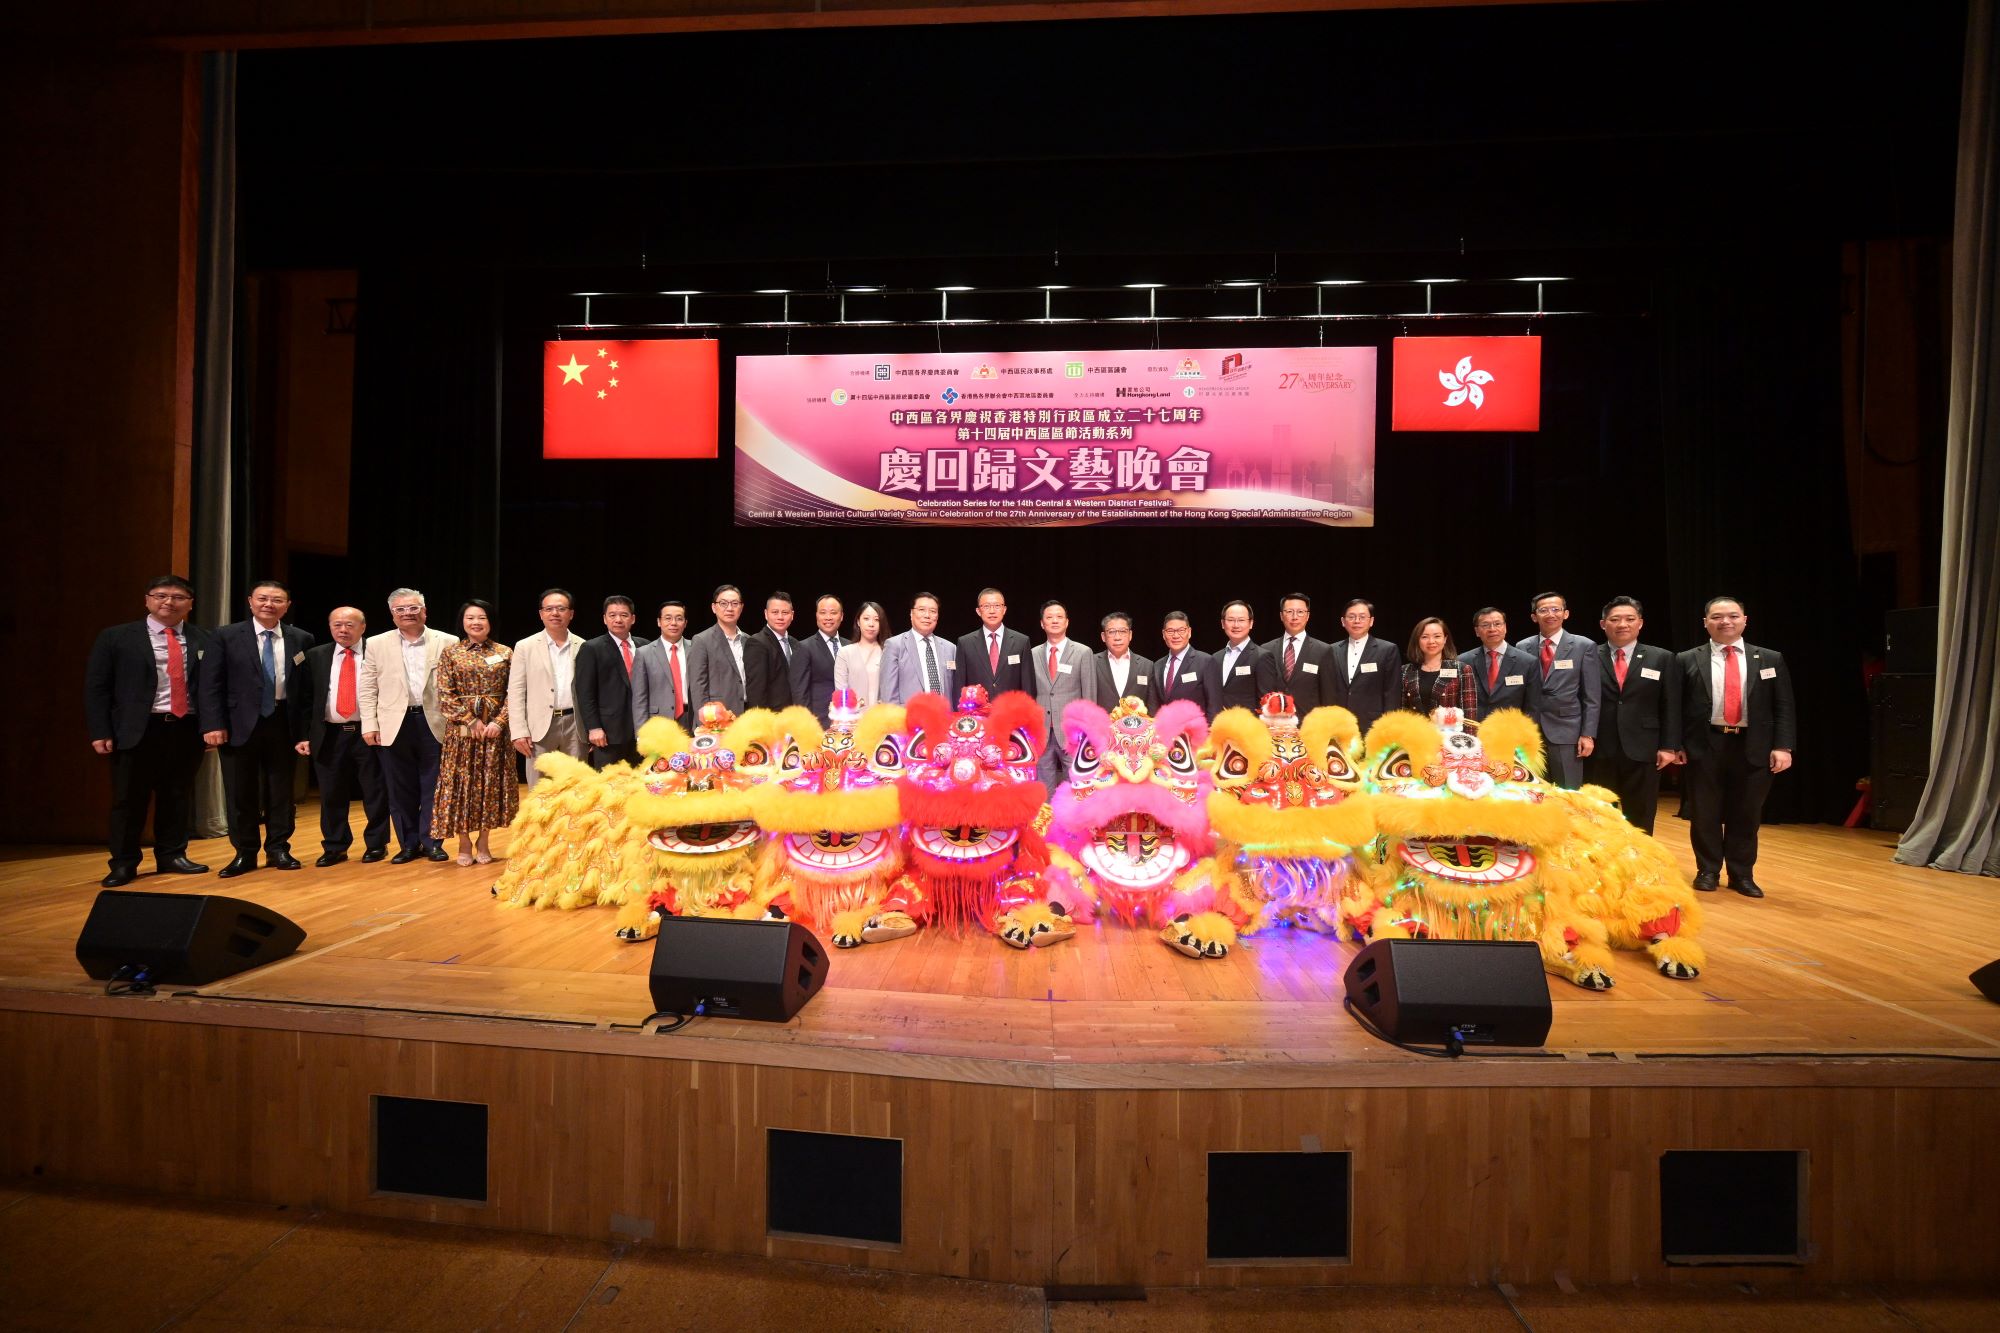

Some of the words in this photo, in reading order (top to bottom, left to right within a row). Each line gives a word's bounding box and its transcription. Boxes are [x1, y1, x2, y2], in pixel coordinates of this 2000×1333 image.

[1303, 381, 1352, 389] ANNIVERSARY
[891, 408, 1201, 424] 中西區各界慶祝香港特別行政區成立二十七周年
[957, 426, 1133, 441] 第十四屆中西區區節活動系列
[879, 446, 1212, 492] 慶回歸文藝晚會
[878, 510, 904, 519] Variety
[1028, 510, 1075, 519] Anniversary
[1184, 510, 1206, 519] Hong
[1207, 510, 1229, 519] Kong
[1231, 510, 1261, 519] Special
[1322, 510, 1352, 519] Region
